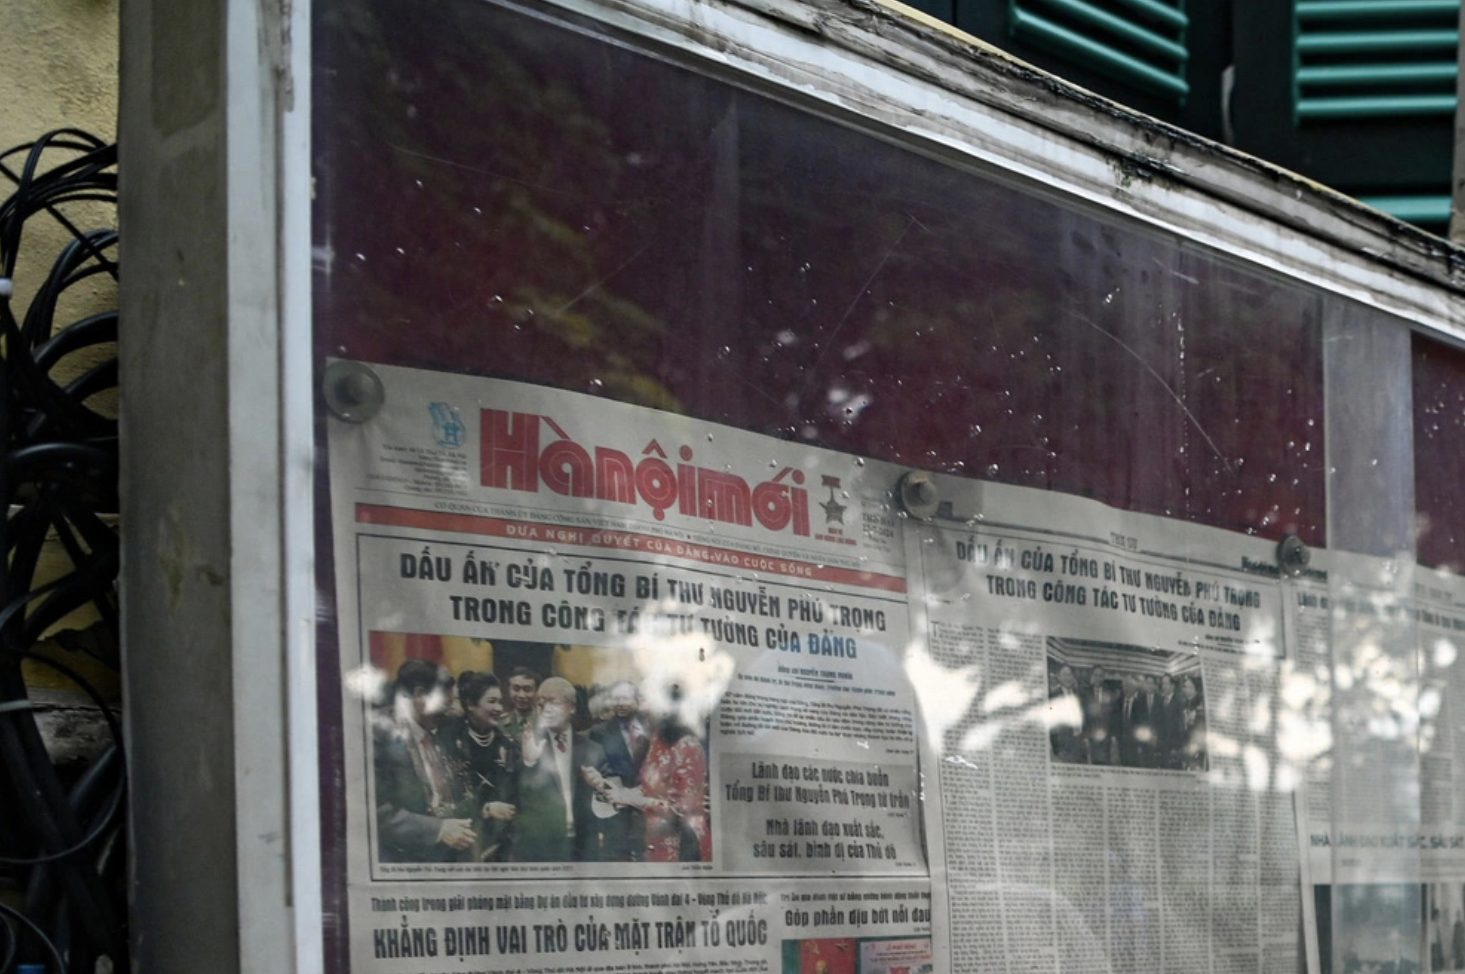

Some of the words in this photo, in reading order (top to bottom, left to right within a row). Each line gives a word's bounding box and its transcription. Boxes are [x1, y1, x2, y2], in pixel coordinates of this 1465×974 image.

[480, 407, 810, 537] Hànộimới
[506, 524, 538, 538] ĐƯA
[545, 529, 583, 543] NGHỊ
[591, 533, 640, 547] QUYẾT
[646, 537, 672, 551] CỦA
[677, 544, 710, 560] ĐẢNG
[743, 556, 775, 571] CUỘC
[780, 562, 812, 577] SỐNG
[1021, 545, 1055, 573] CỦA
[1060, 548, 1099, 579] TỔNG
[1103, 560, 1116, 583] BÍ
[1119, 566, 1142, 589] THƯ
[1144, 571, 1192, 598] NGUYỄN
[1196, 580, 1221, 603] PHÚ
[1224, 585, 1261, 610] TRỌNG
[400, 545, 452, 582] DẤU
[507, 558, 554, 592] CỦA
[563, 560, 625, 598] TỔNG
[636, 574, 659, 600] BÍ
[667, 579, 704, 606] THƯ
[710, 586, 781, 619] NGUYỄN
[788, 595, 824, 624] PHÚ
[829, 603, 887, 634] TRỌNG
[986, 574, 1037, 600] TRONG
[1043, 579, 1087, 606] CÔNG
[1093, 585, 1119, 610] TÁC
[1122, 592, 1136, 613] TƯ
[1181, 602, 1205, 625] CỦA
[1209, 607, 1241, 632] ĐẢNG
[449, 595, 532, 627] TRONG
[542, 600, 606, 633] CÔNG
[765, 623, 801, 653] CỦA
[807, 629, 858, 659] ĐẢNG
[725, 779, 754, 803] Tổng
[757, 783, 771, 802] Bí
[752, 761, 779, 780] Lãnh
[782, 764, 800, 784] đạo
[752, 840, 776, 858] sâu
[766, 818, 790, 837] Nhà
[374, 914, 438, 959] KHẲNG
[444, 926, 490, 963] ĐỊNH
[496, 924, 527, 955] VAI
[533, 918, 568, 954] TRÒ
[574, 914, 610, 952] CỦA
[614, 917, 651, 956] MẶT
[655, 914, 696, 954] TRẬN
[701, 908, 721, 948] TỔ
[725, 909, 768, 949] QUỐC
[785, 908, 810, 927] Góp
[814, 904, 845, 927] phần
